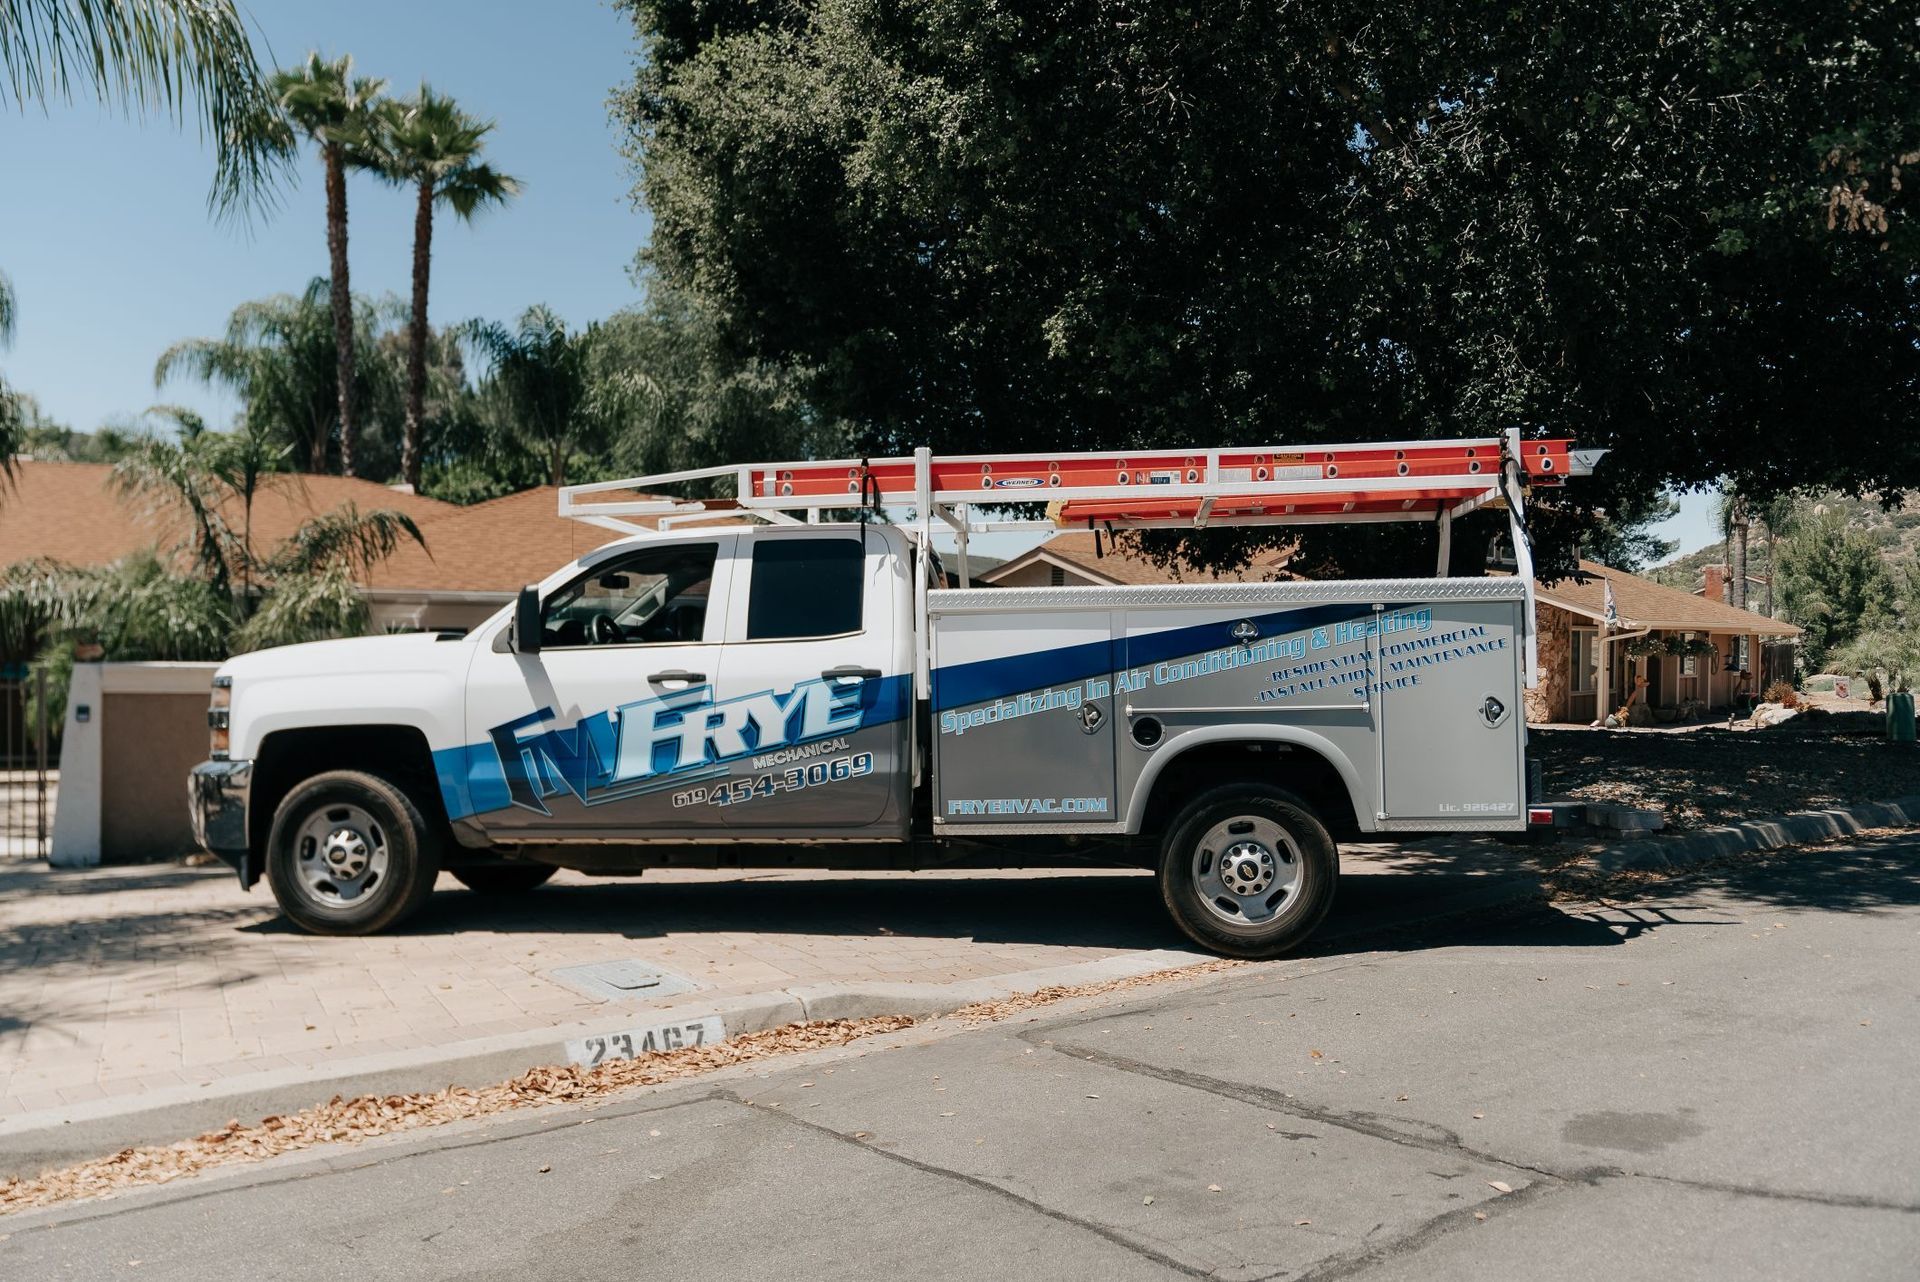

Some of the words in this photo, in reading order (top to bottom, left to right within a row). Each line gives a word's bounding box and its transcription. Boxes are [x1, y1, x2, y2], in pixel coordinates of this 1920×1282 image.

[940, 683, 1083, 735] Specializing
[1086, 679, 1109, 700] In
[1113, 669, 1150, 695] Air
[1154, 635, 1306, 686] Conditioning
[1311, 626, 1331, 650] &
[1335, 607, 1432, 646] Heating
[1258, 667, 1377, 702] INSTALLATION
[1389, 638, 1510, 672] MAINTENANCE
[1271, 650, 1376, 682] RESIDENTIAL
[1379, 625, 1490, 657] COMMERCIAL
[1353, 674, 1421, 697] SERVICE
[605, 678, 865, 785] FRYE
[752, 737, 850, 770] MECHANICAL
[672, 788, 708, 808] 619
[708, 752, 874, 807] 454-3069
[948, 797, 1108, 815] FRYEHVAC.COM
[1463, 803, 1515, 812] 926427
